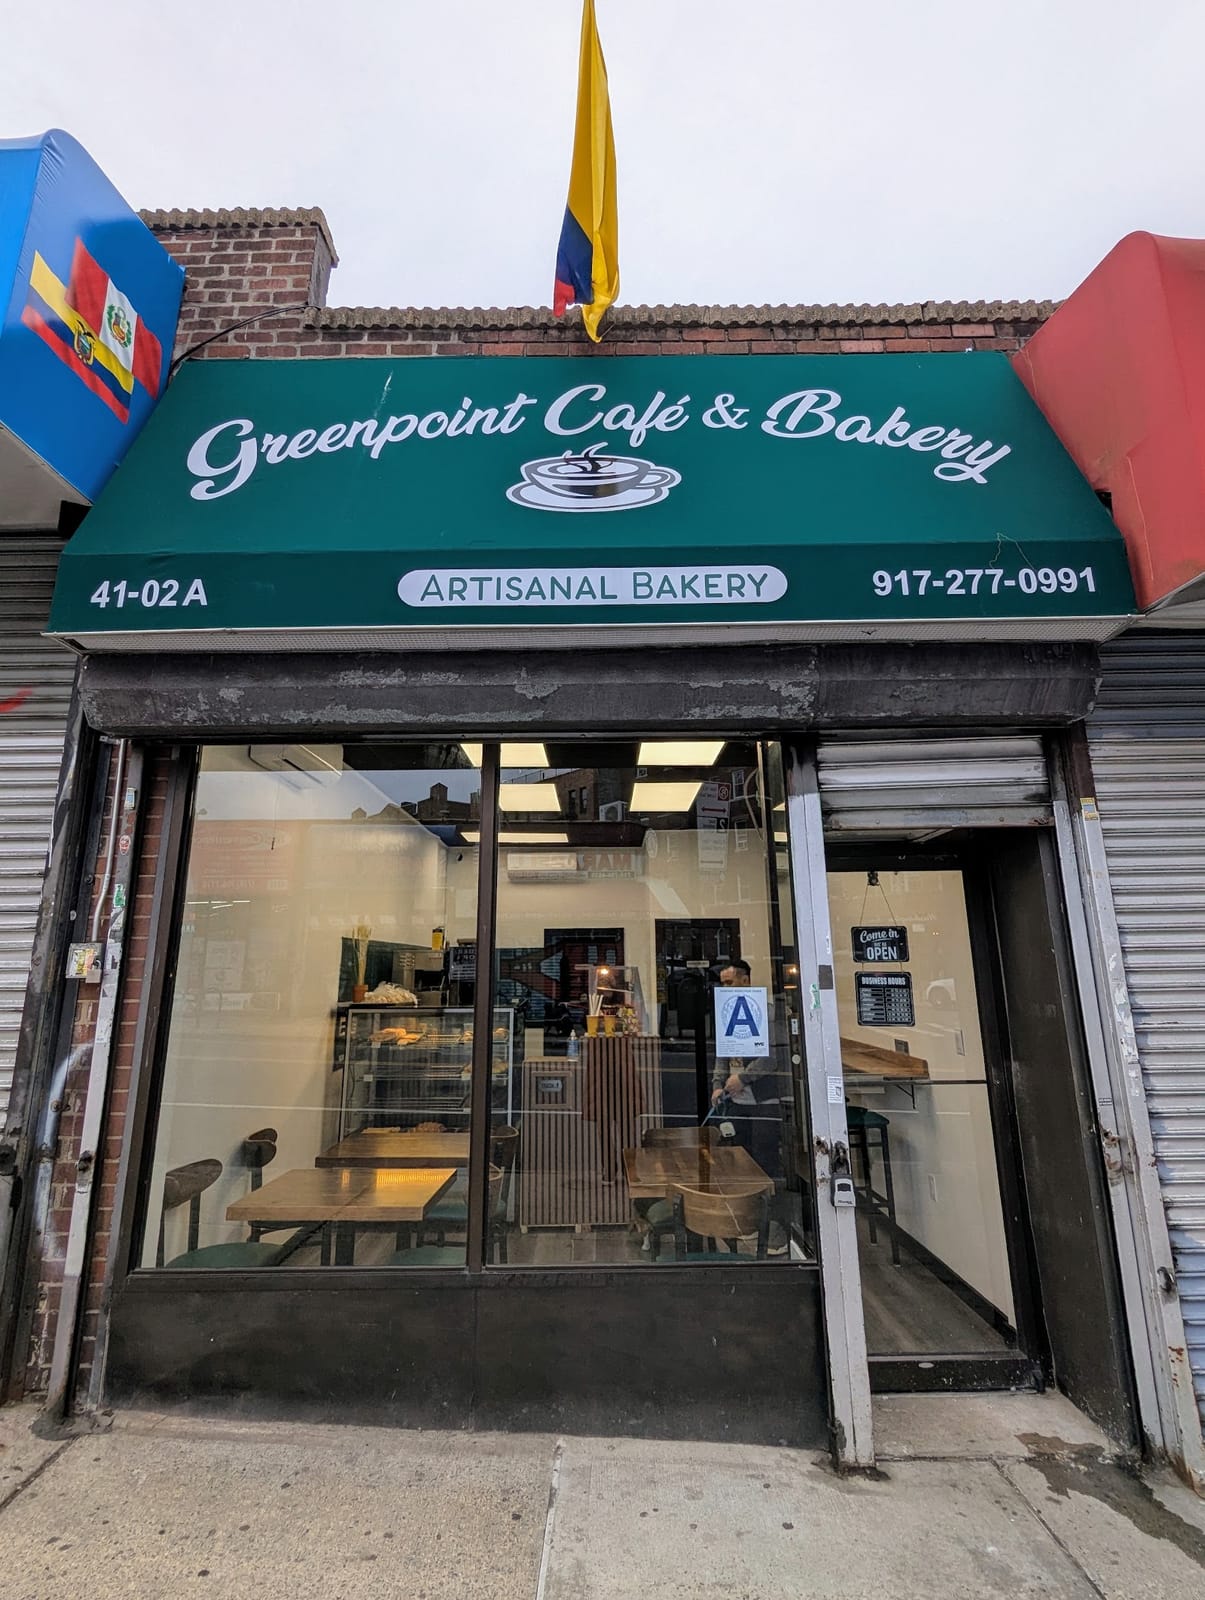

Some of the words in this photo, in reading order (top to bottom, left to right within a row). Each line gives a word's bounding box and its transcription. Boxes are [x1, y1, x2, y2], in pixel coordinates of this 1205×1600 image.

[187, 393, 537, 500] Greenpoint
[544, 385, 690, 448] Café
[702, 394, 749, 430] &
[761, 390, 1010, 484] Bakery
[421, 573, 618, 603] ARTISANAL
[633, 571, 770, 602] BAKERY
[872, 566, 1096, 597] 917-277-0991
[860, 930, 887, 943] Come
[888, 929, 900, 939] in
[866, 946, 897, 960] OPEN
[725, 996, 761, 1037] A
